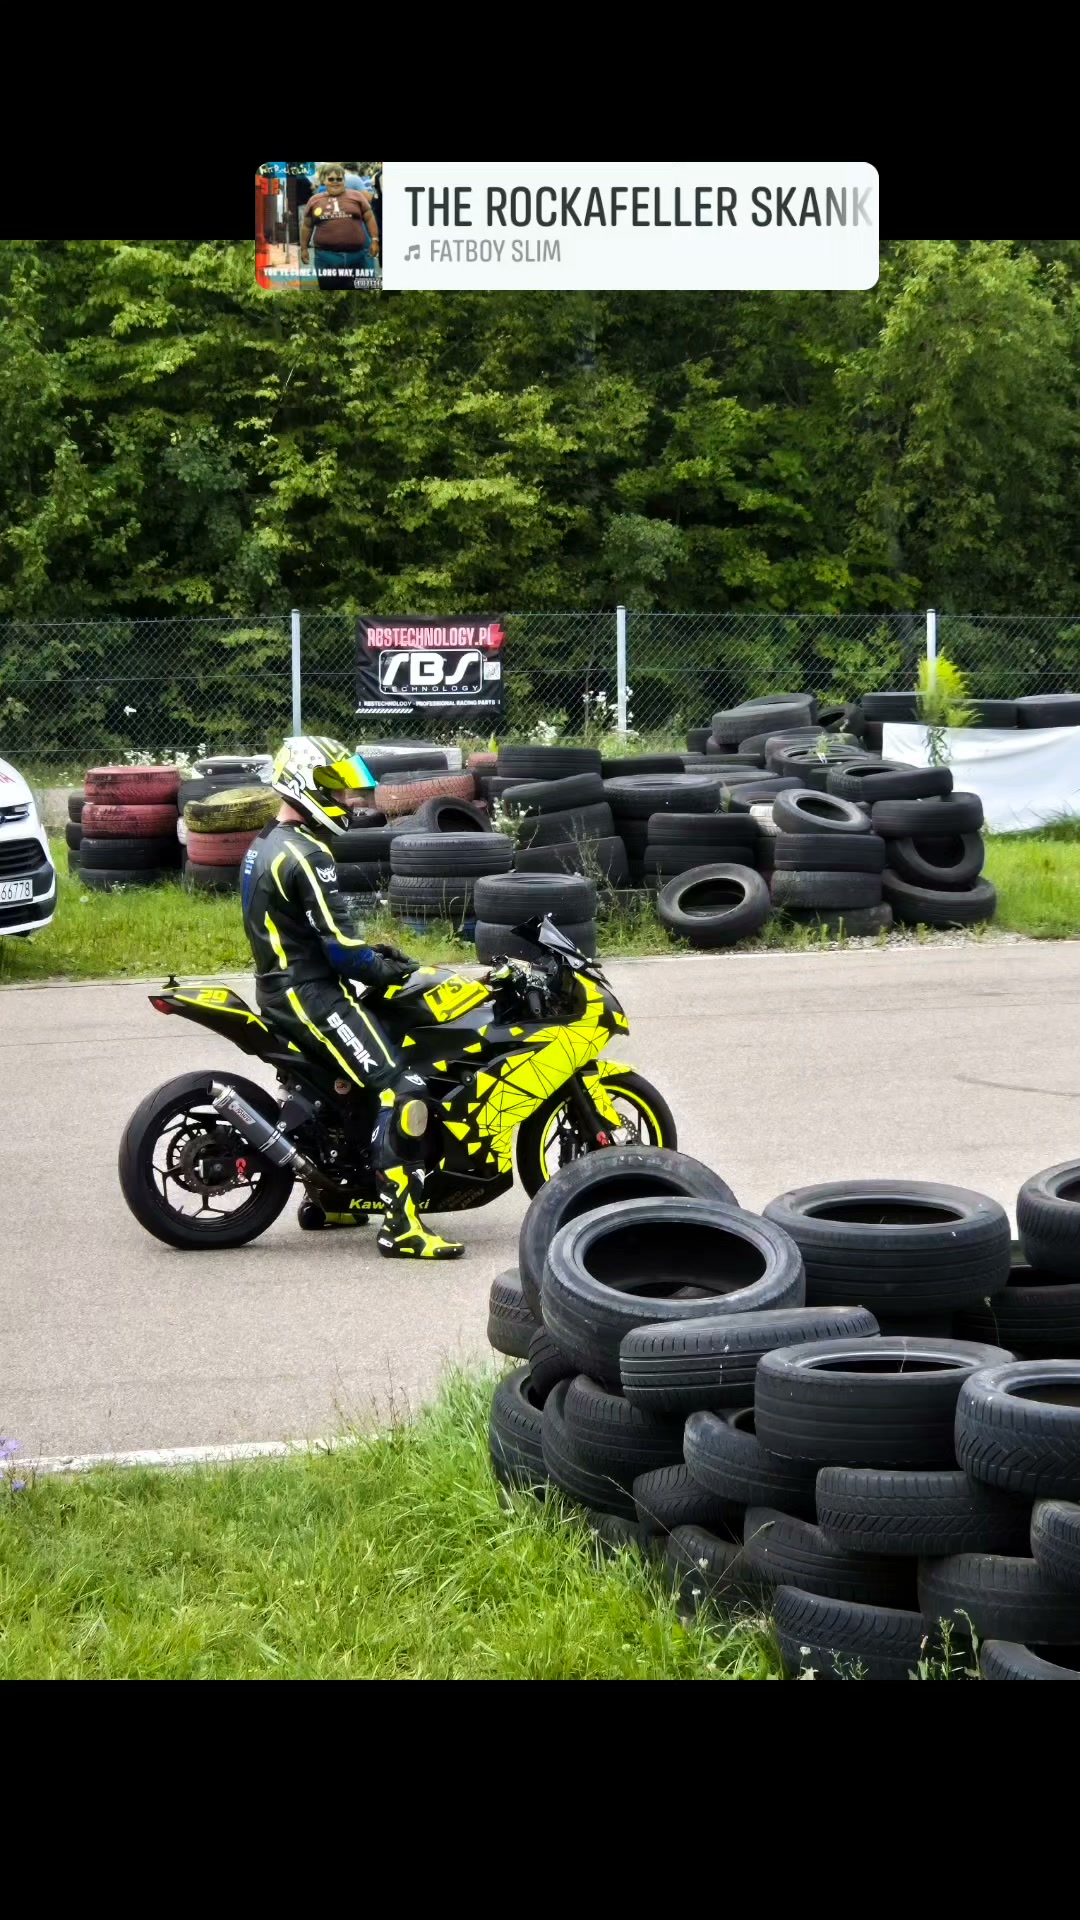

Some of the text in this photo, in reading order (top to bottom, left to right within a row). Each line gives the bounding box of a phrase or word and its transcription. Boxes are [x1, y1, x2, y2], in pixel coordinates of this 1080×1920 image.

[367, 627, 494, 647] RBSTECHNOLOGY.PL
[1, 882, 31, 900] 66778
[196, 989, 229, 1004] 29
[326, 1012, 379, 1073] BERIK
[349, 1198, 430, 1210] Kawki
